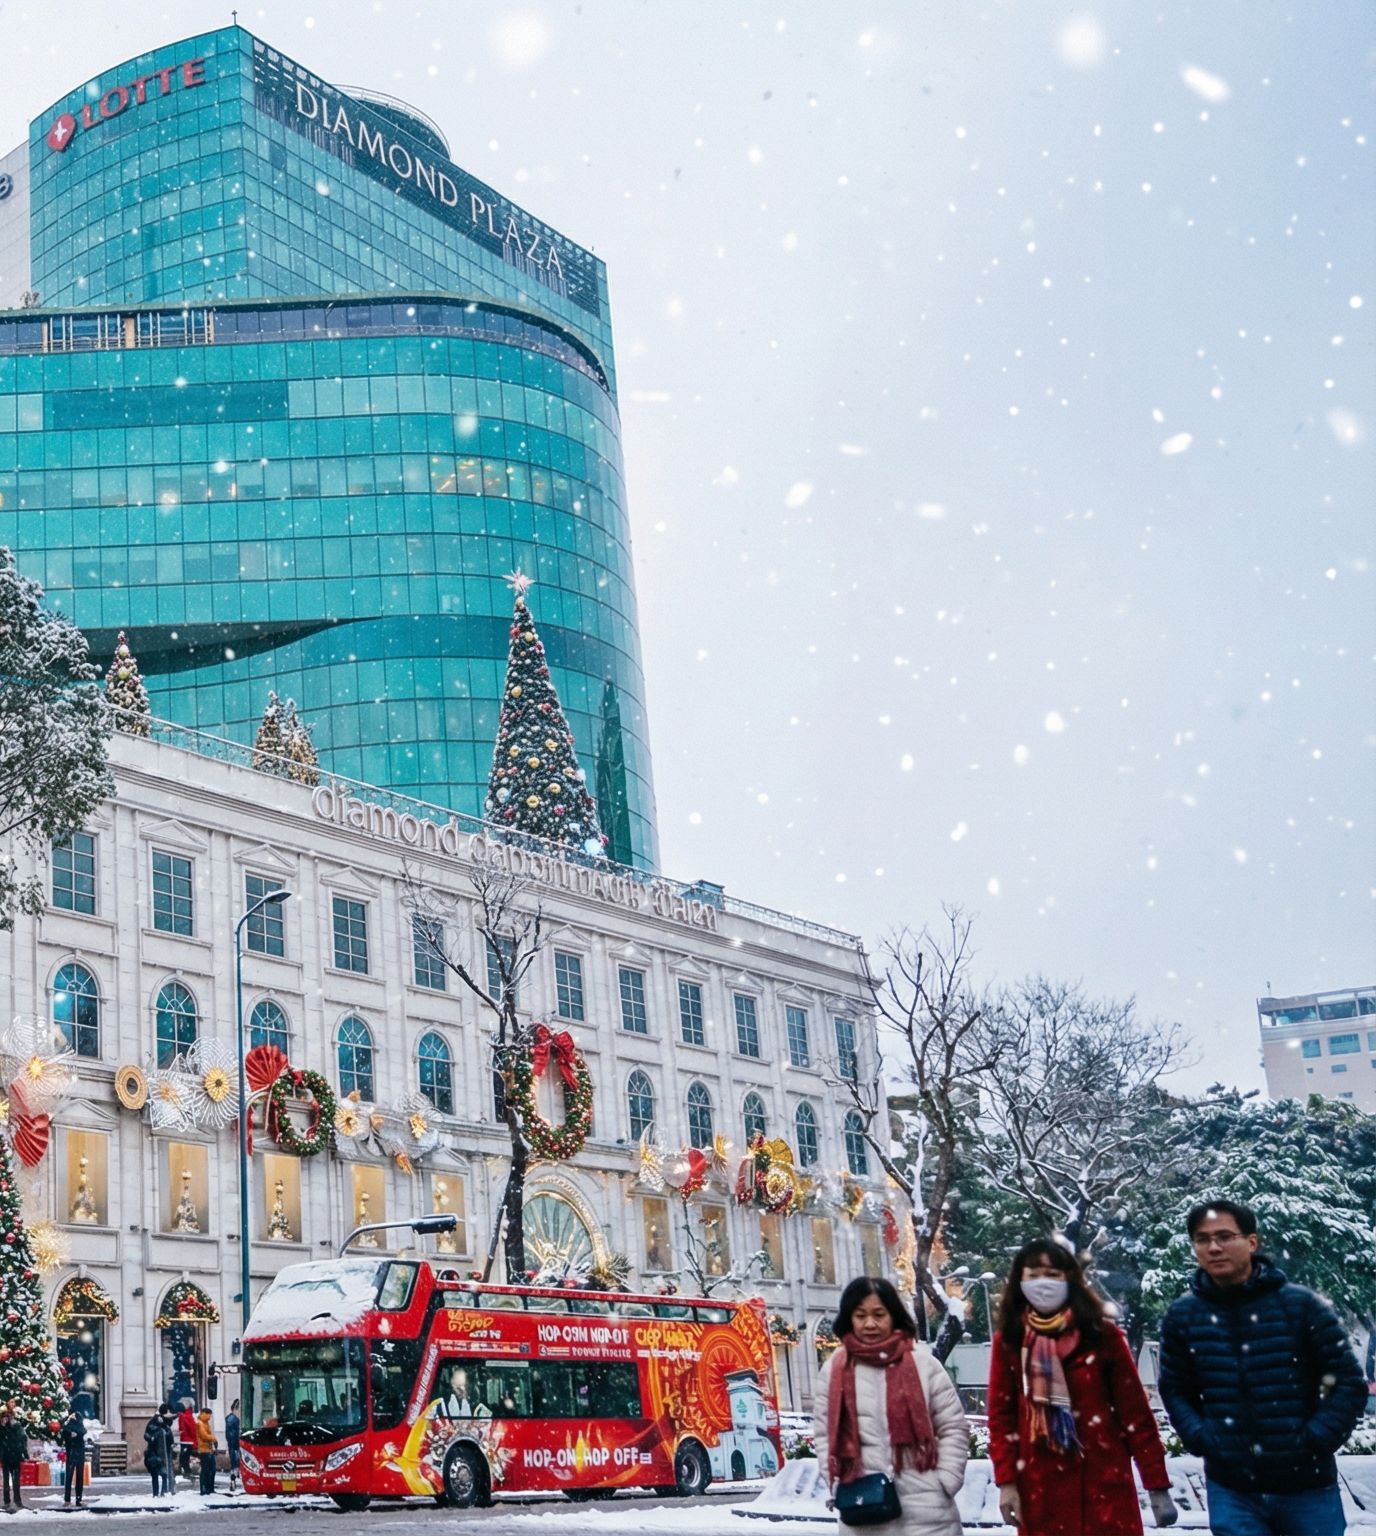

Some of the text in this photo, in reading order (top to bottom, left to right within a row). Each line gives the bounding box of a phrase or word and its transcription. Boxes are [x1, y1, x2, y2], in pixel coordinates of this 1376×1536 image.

[82, 57, 206, 131] LOTTE
[296, 81, 565, 280] DIAMOND PLAZA
[312, 776, 459, 856] diamond
